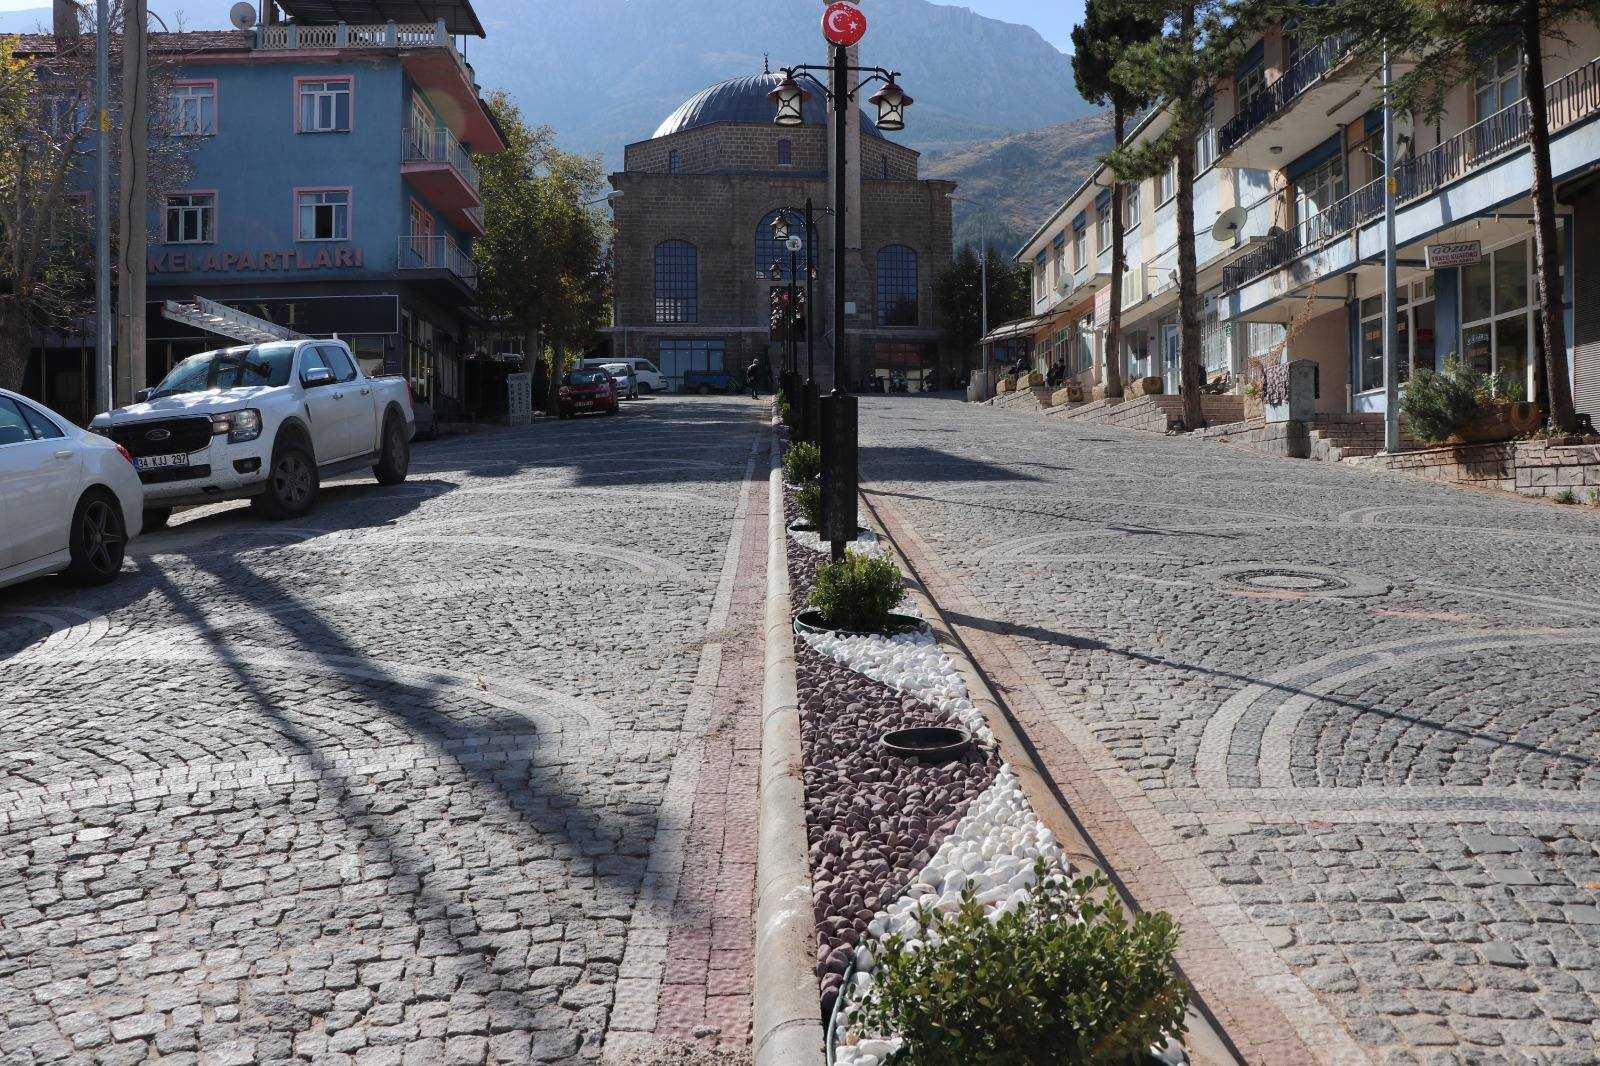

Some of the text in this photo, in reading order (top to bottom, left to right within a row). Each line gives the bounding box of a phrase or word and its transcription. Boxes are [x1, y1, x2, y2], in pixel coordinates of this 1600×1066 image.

[203, 247, 364, 272] APARTLARI
[138, 457, 148, 467] 34
[171, 453, 186, 464] 297
